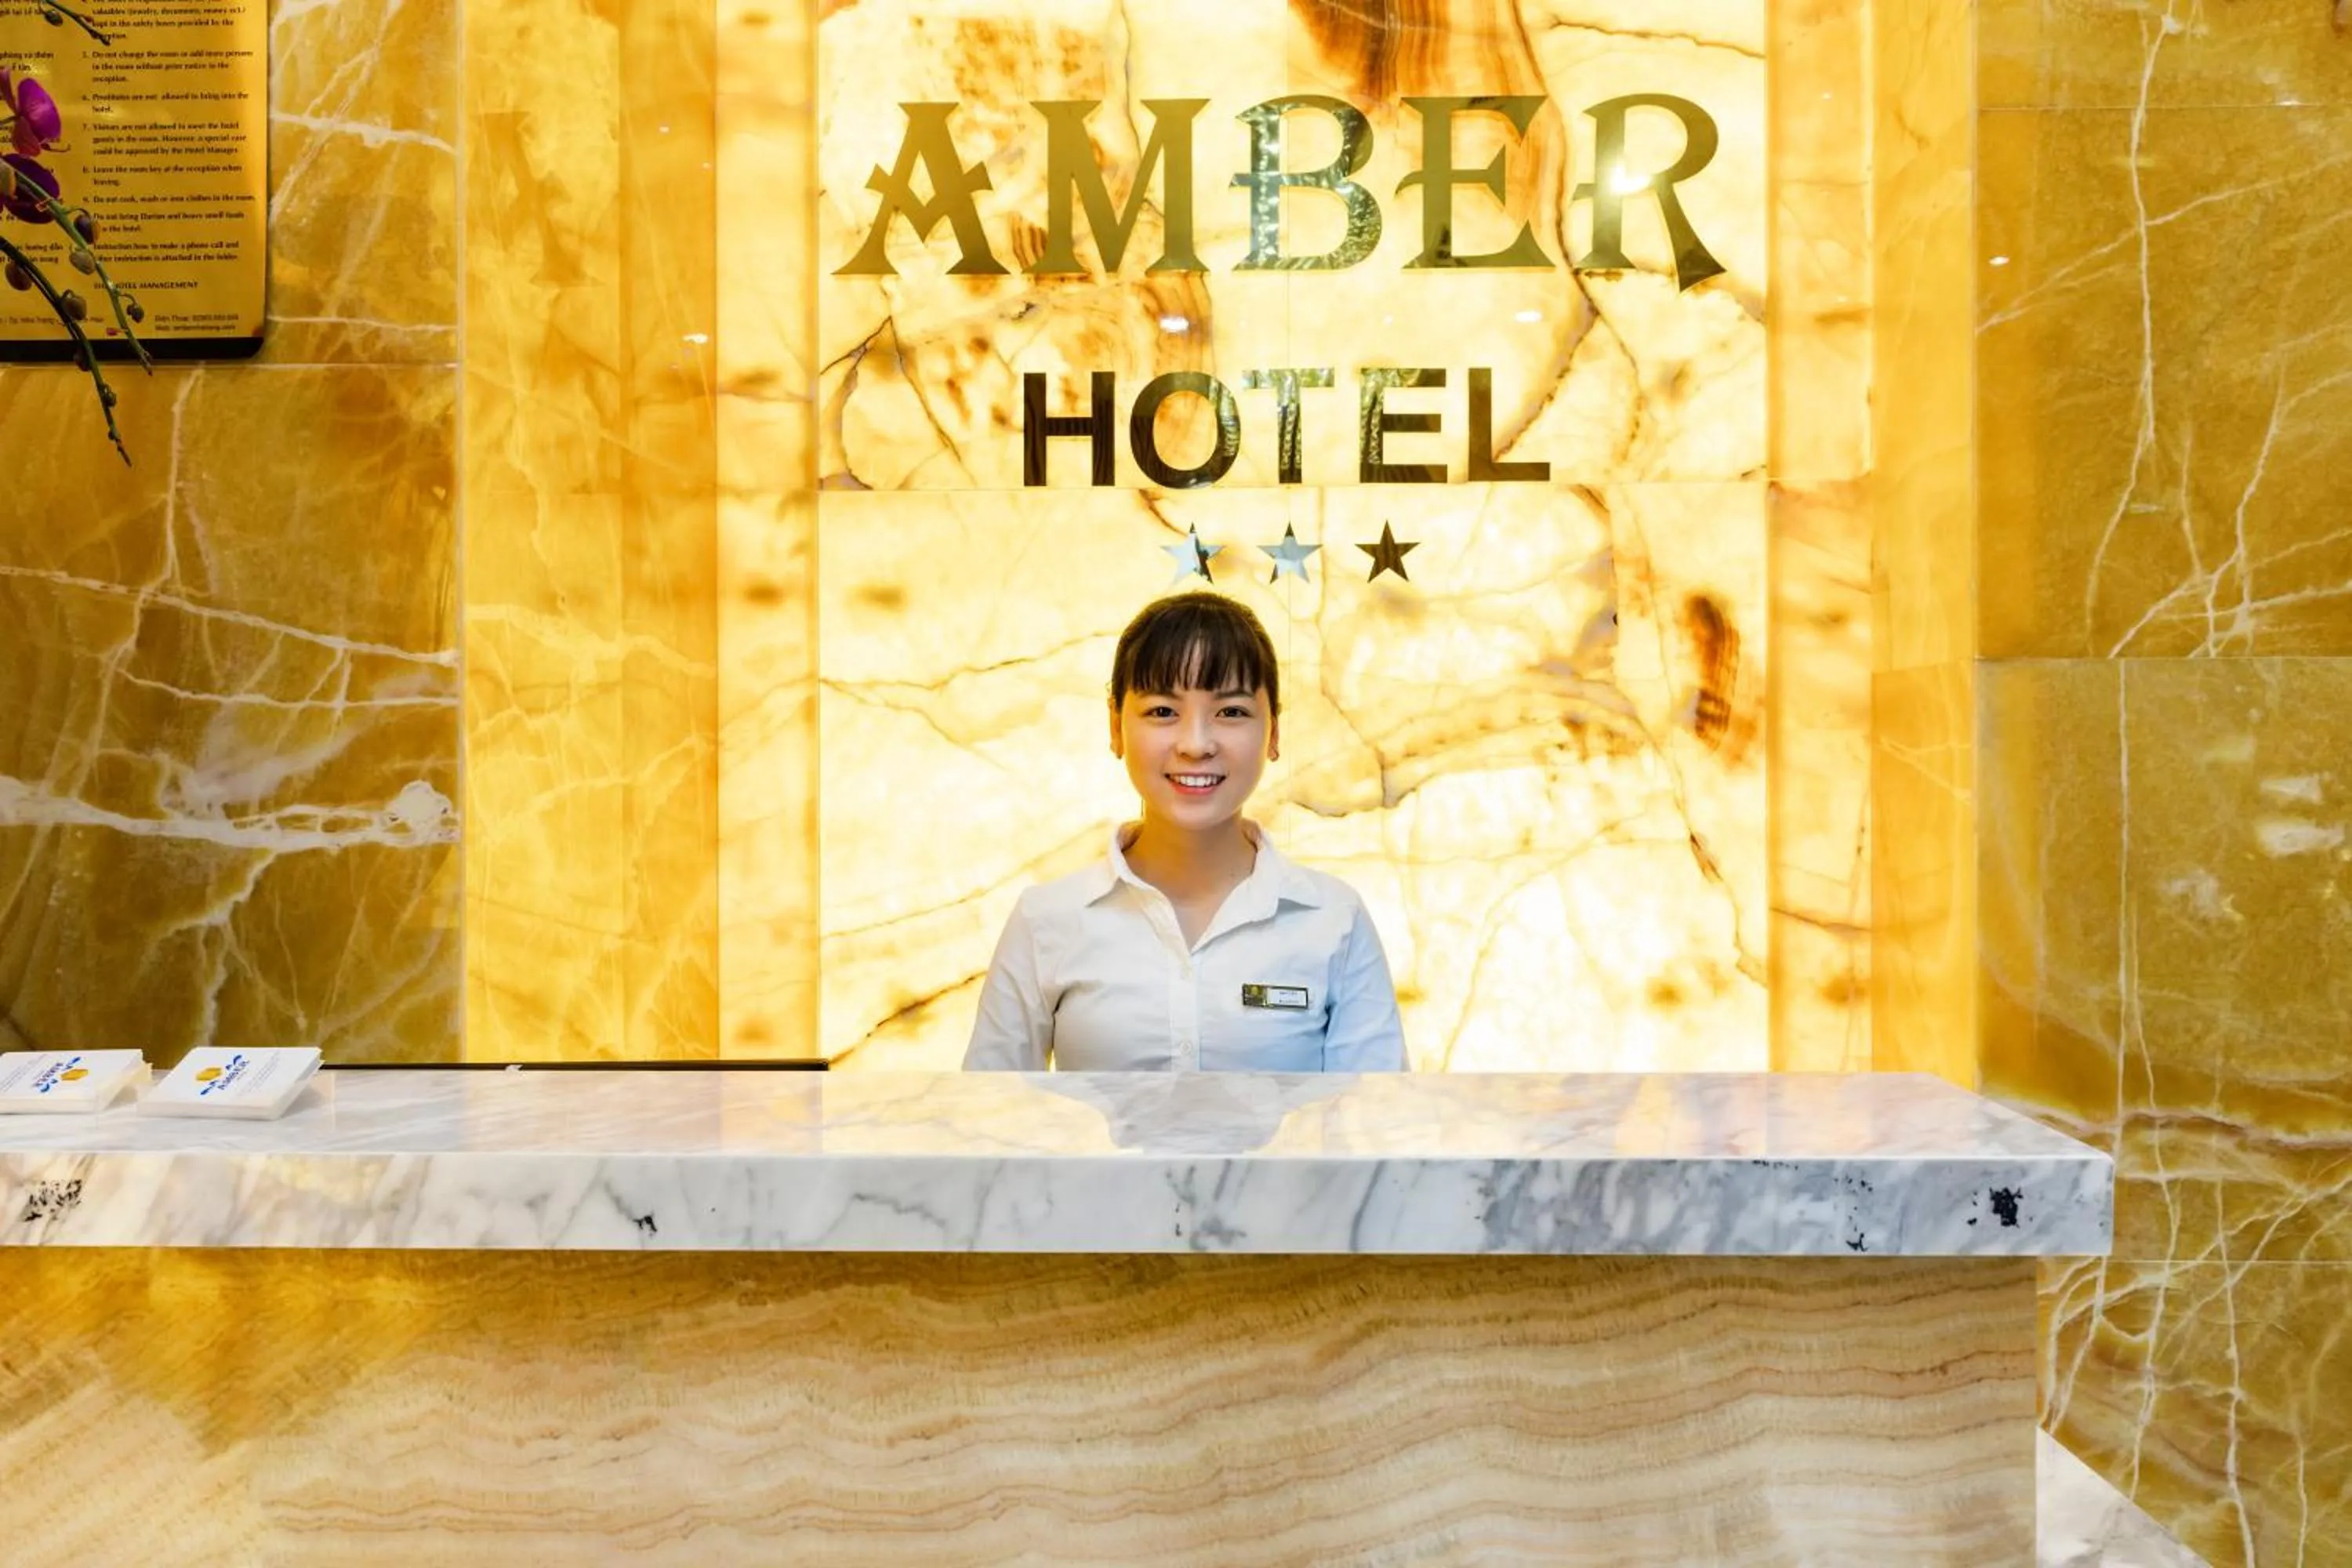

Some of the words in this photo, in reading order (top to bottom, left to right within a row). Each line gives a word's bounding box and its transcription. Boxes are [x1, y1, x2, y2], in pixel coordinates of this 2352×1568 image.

[162, 92, 190, 100] allowed
[830, 93, 1727, 293] AMBER
[140, 281, 199, 290] MANAGEMENT
[1023, 366, 1552, 488] HOTEL
